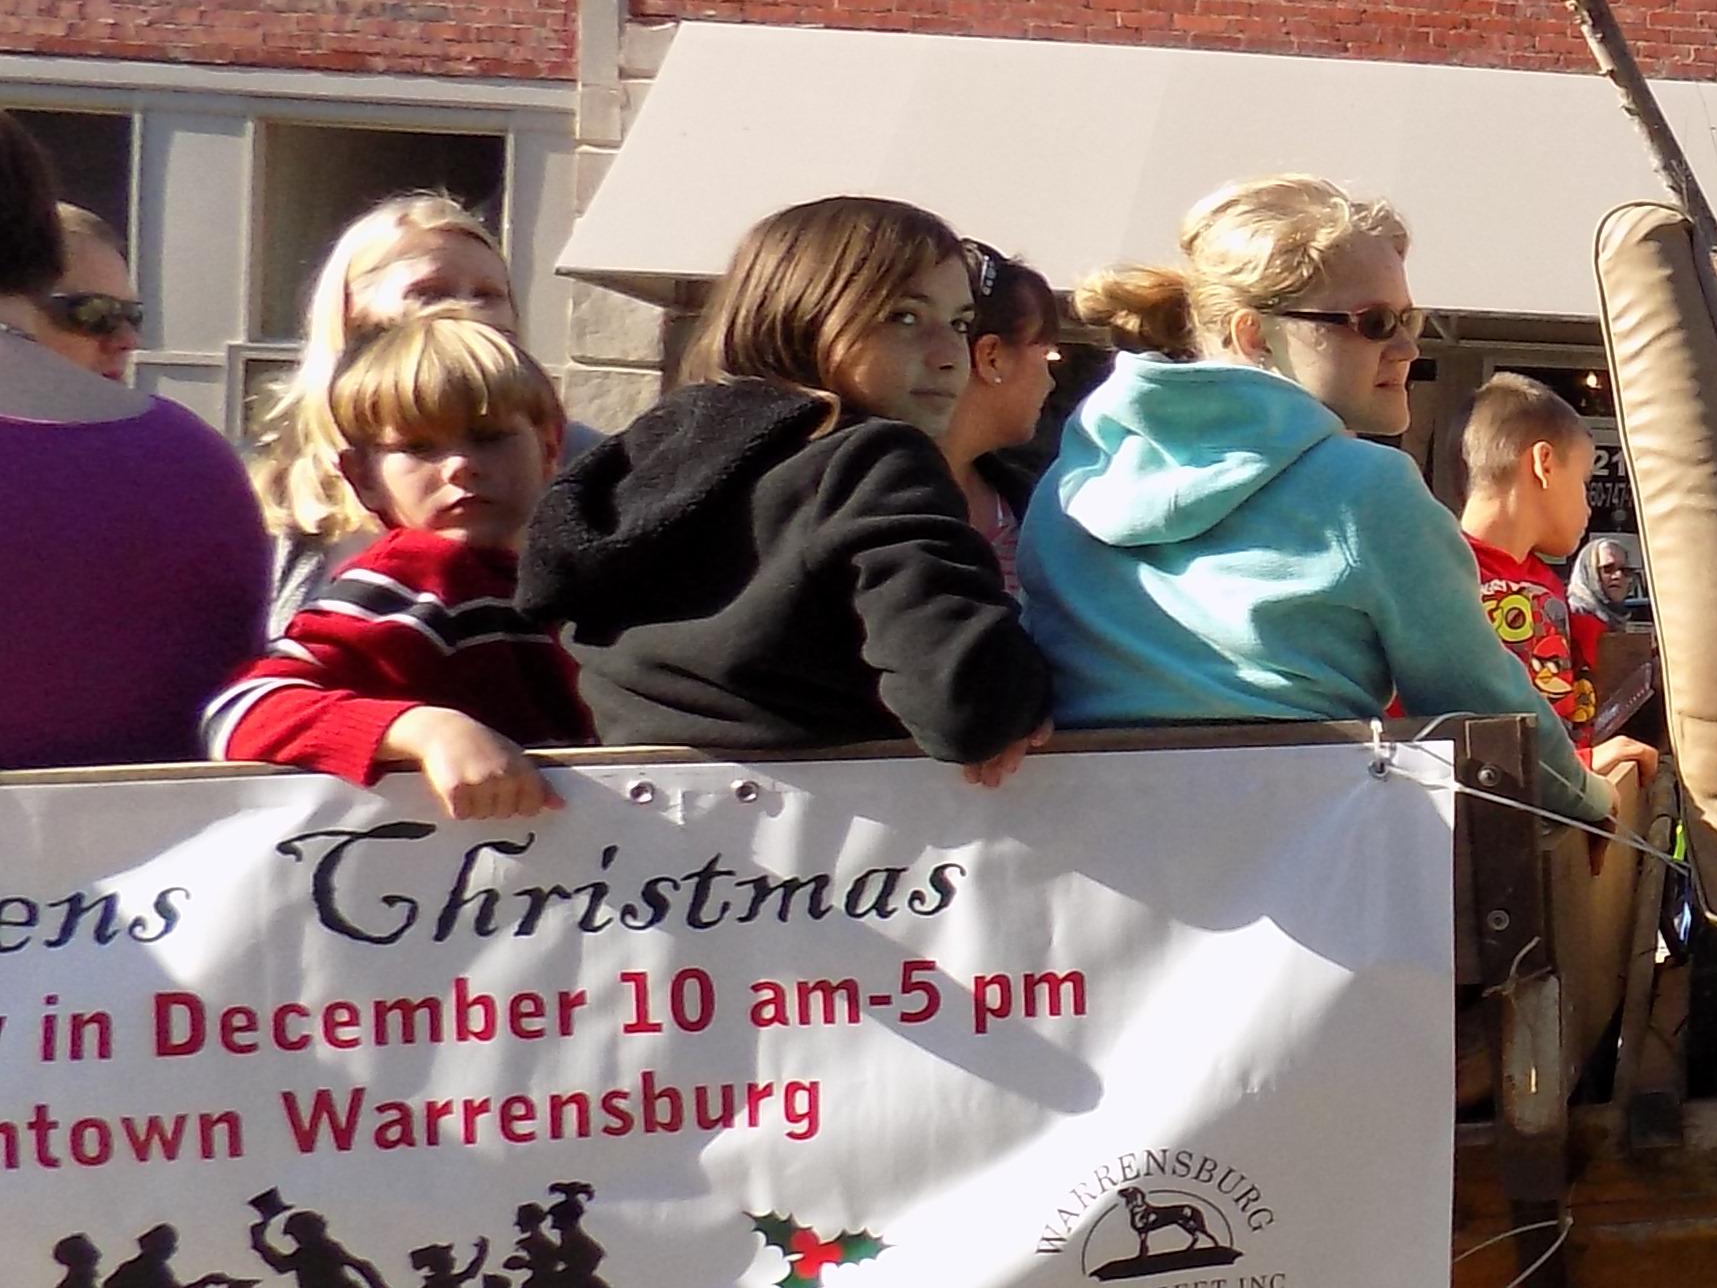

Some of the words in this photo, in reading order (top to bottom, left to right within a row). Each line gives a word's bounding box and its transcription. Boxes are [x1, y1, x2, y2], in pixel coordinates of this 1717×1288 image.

[277, 821, 967, 944] Christmas
[40, 994, 112, 1062] in
[152, 976, 588, 1058] December
[619, 967, 716, 1035] 10
[973, 968, 1087, 1035] pm
[281, 1070, 822, 1154] Warrensburg
[1036, 1148, 1275, 1254] WARRENSBURG
